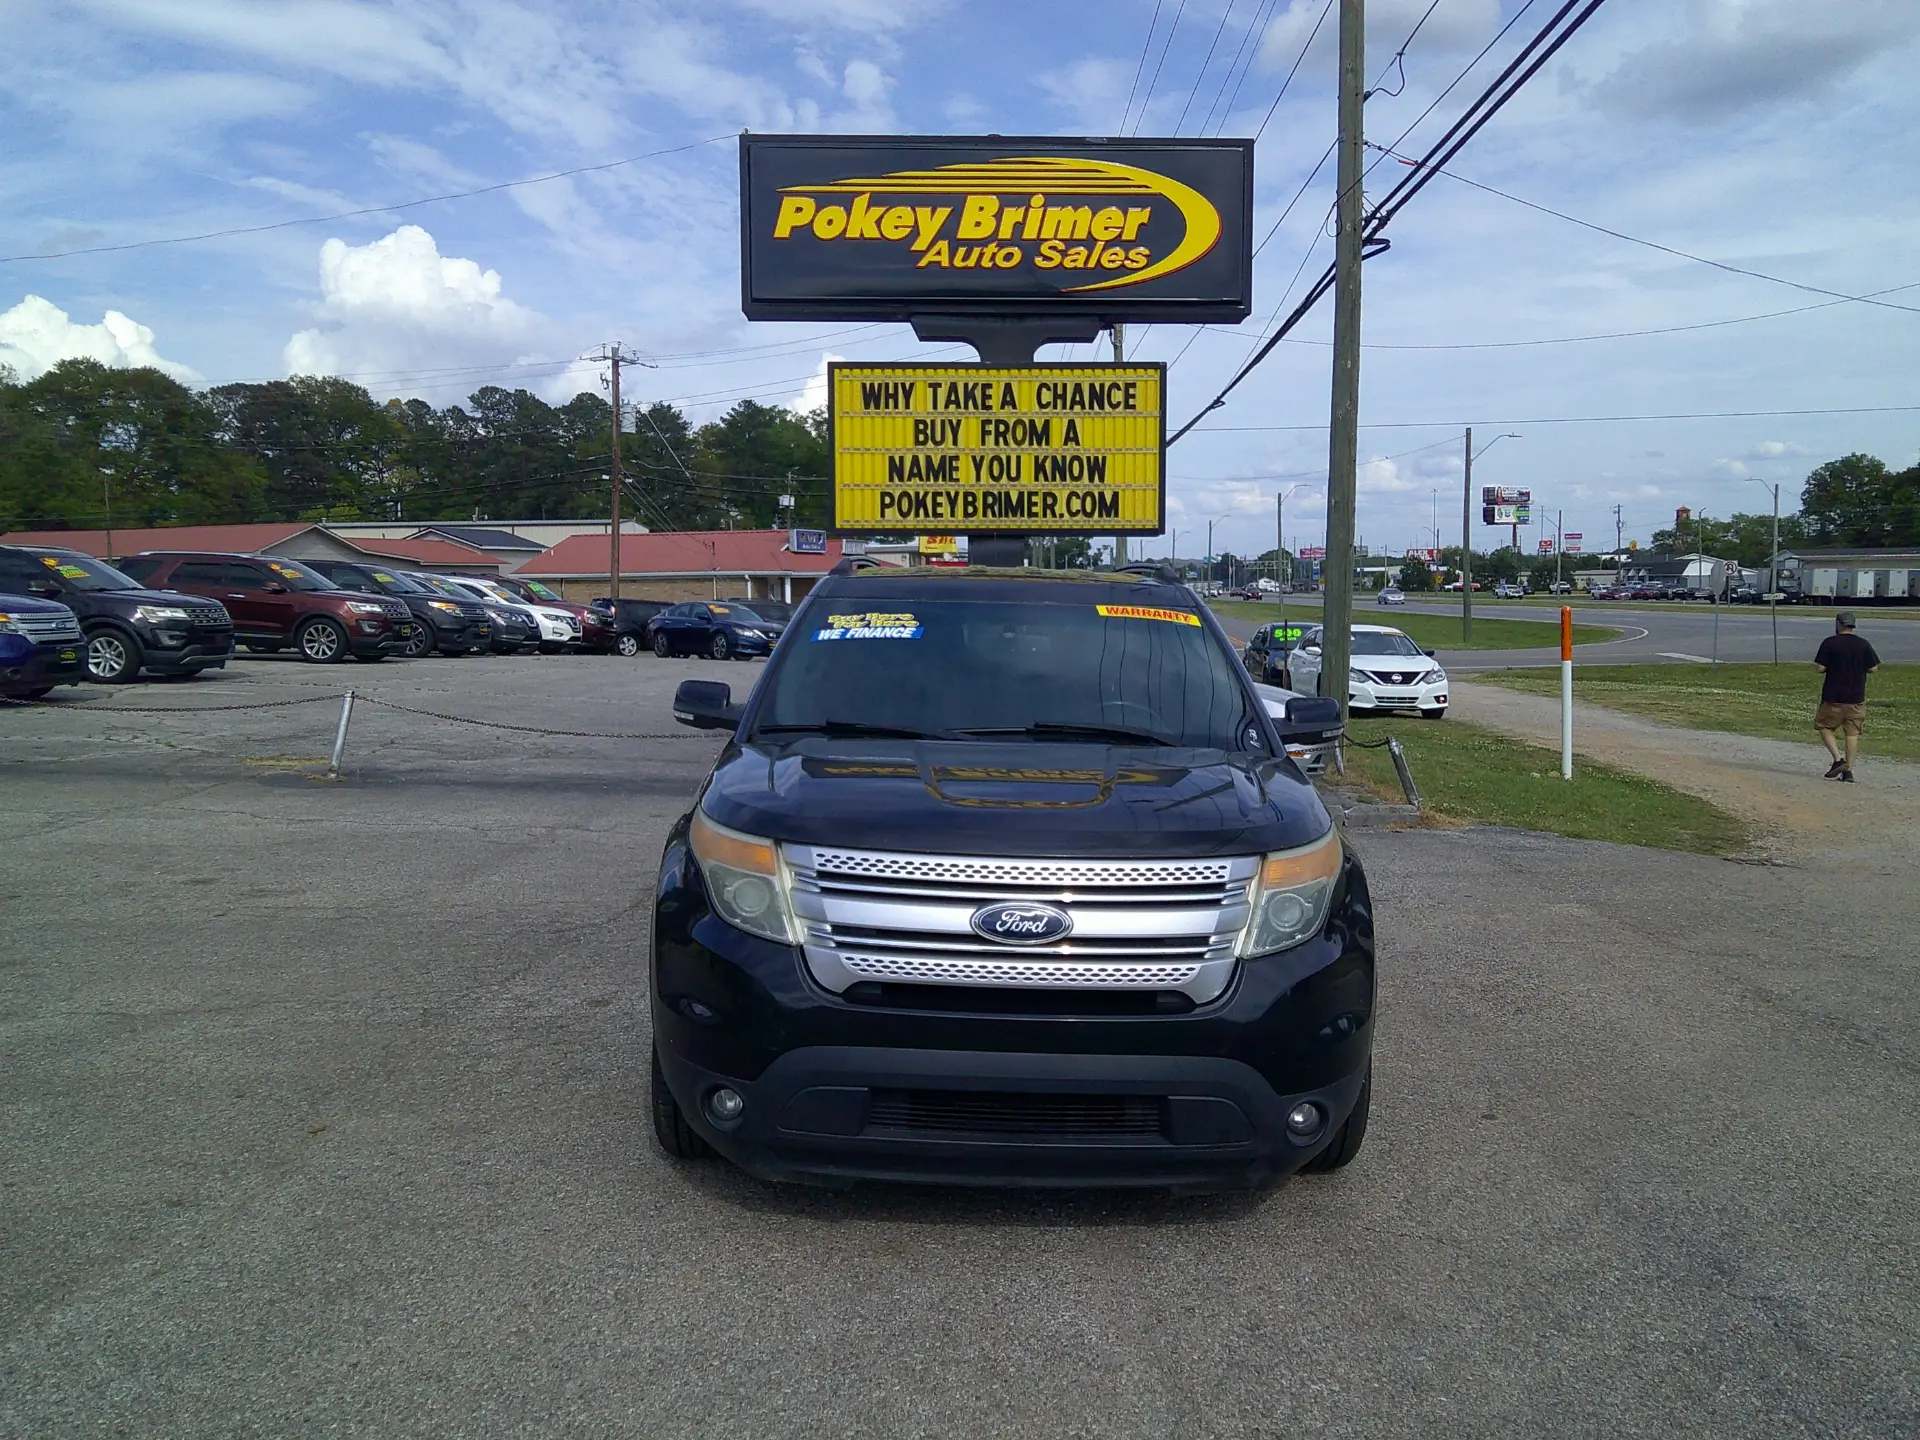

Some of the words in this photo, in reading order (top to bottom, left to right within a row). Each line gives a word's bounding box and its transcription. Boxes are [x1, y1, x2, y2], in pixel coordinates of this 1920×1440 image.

[773, 193, 953, 252] Pokey
[956, 194, 1151, 241] Brimer
[916, 240, 1024, 269] Auto
[1034, 239, 1151, 269] Sales
[861, 382, 915, 410] WHY
[928, 382, 993, 410] TAKE
[1000, 382, 1017, 410] A
[1036, 382, 1137, 410] CHANCE
[914, 419, 962, 447] BUY
[980, 419, 1050, 447] FROM
[1063, 419, 1081, 447] A
[888, 455, 960, 483] NAME
[971, 455, 1022, 483] YOU
[1034, 455, 1107, 483] KNOW
[880, 491, 1120, 519] POKEYBRIMER.COM
[1105, 606, 1191, 622] WARRANTY
[818, 629, 845, 640] WE
[846, 627, 916, 638] FINANCE
[996, 910, 1053, 932] Ford
